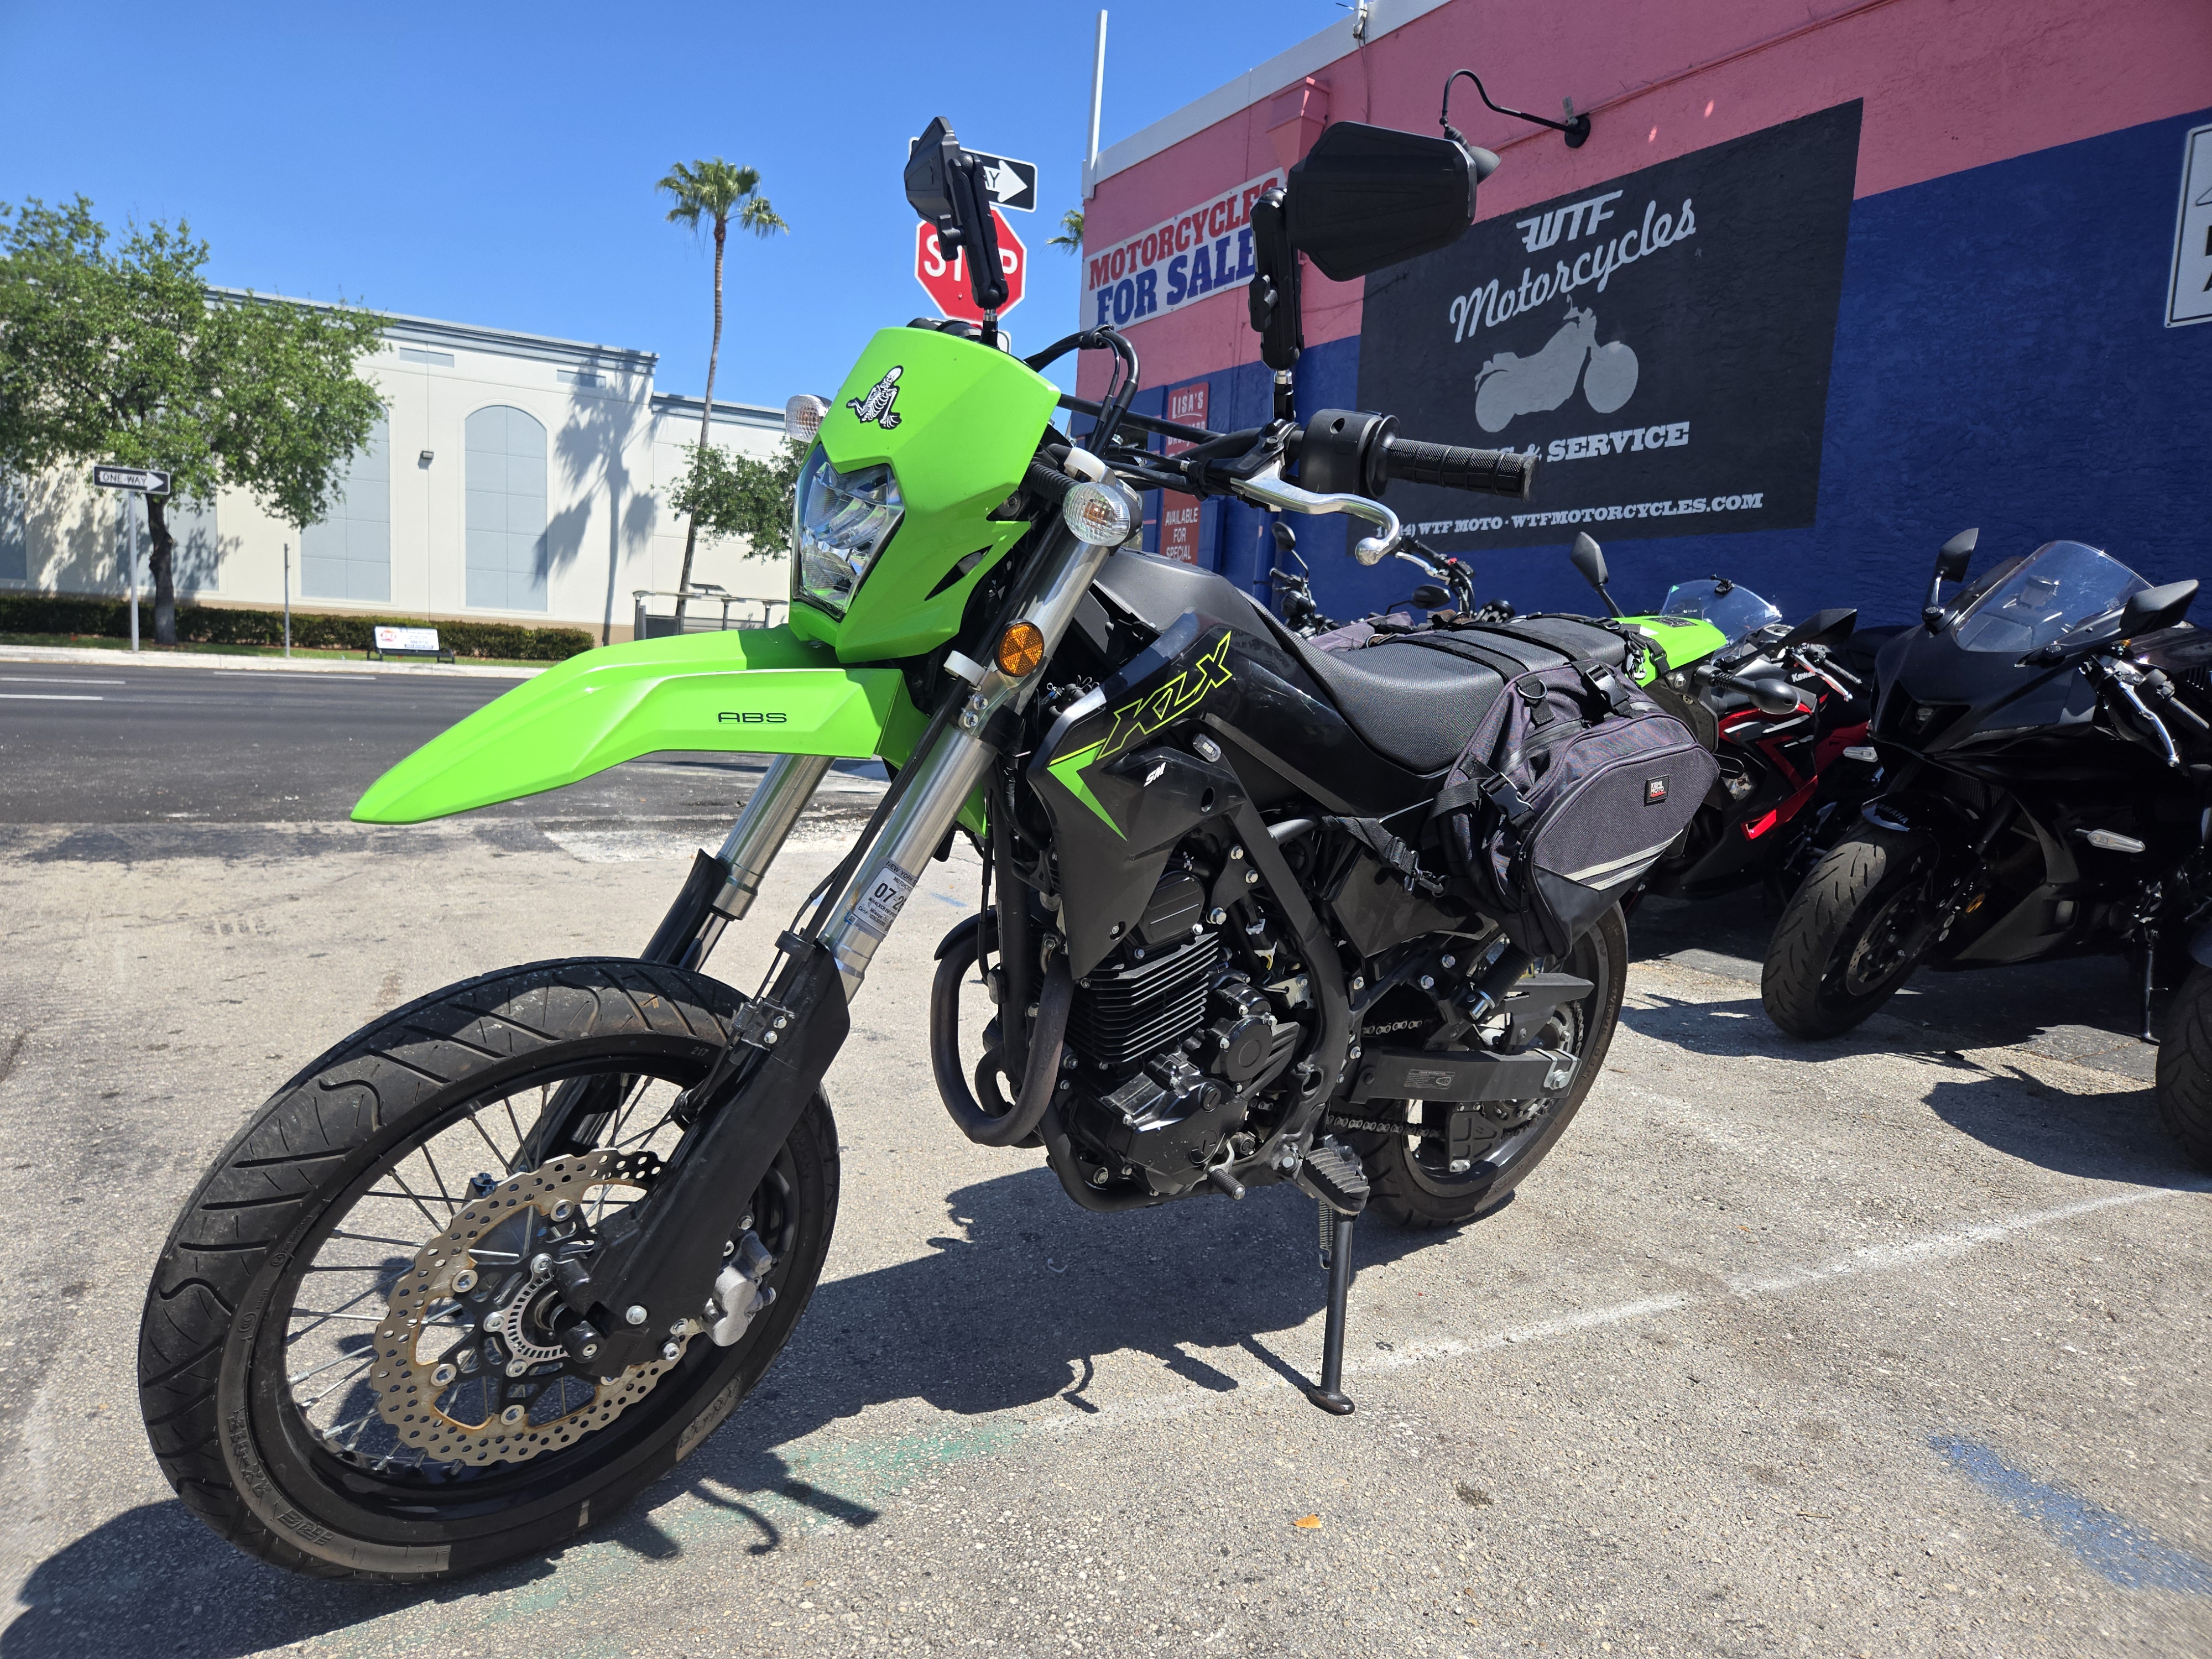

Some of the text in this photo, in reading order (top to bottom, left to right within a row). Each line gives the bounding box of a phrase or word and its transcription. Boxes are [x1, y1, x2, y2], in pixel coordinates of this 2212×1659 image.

[983, 170, 1001, 189] AY
[1516, 190, 1623, 253] WTF
[924, 234, 1018, 281] STP
[1096, 227, 1256, 327] FOR SALE
[1449, 199, 1697, 343] Motorcycles
[1172, 391, 1204, 419] LISA'S
[1547, 421, 1690, 463] SERVICE
[103, 473, 147, 486] ONE WAY
[1165, 507, 1199, 526] AVAILABLE
[1418, 520, 1452, 535] WTF
[1454, 517, 1503, 533] MOTO
[1511, 493, 1764, 529] WTFMOTORCYCLES.COM
[1173, 527, 1186, 544] FOR
[1166, 544, 1191, 560] SPECIAL
[718, 712, 787, 723] ABS
[1144, 761, 1166, 787] SM
[1650, 781, 1662, 789] KEMI
[1650, 786, 1665, 795] MOTO
[1876, 804, 1909, 824] AMAHA
[886, 860, 900, 873] NEW
[900, 870, 914, 883] YORK
[690, 1046, 710, 1057] 217
